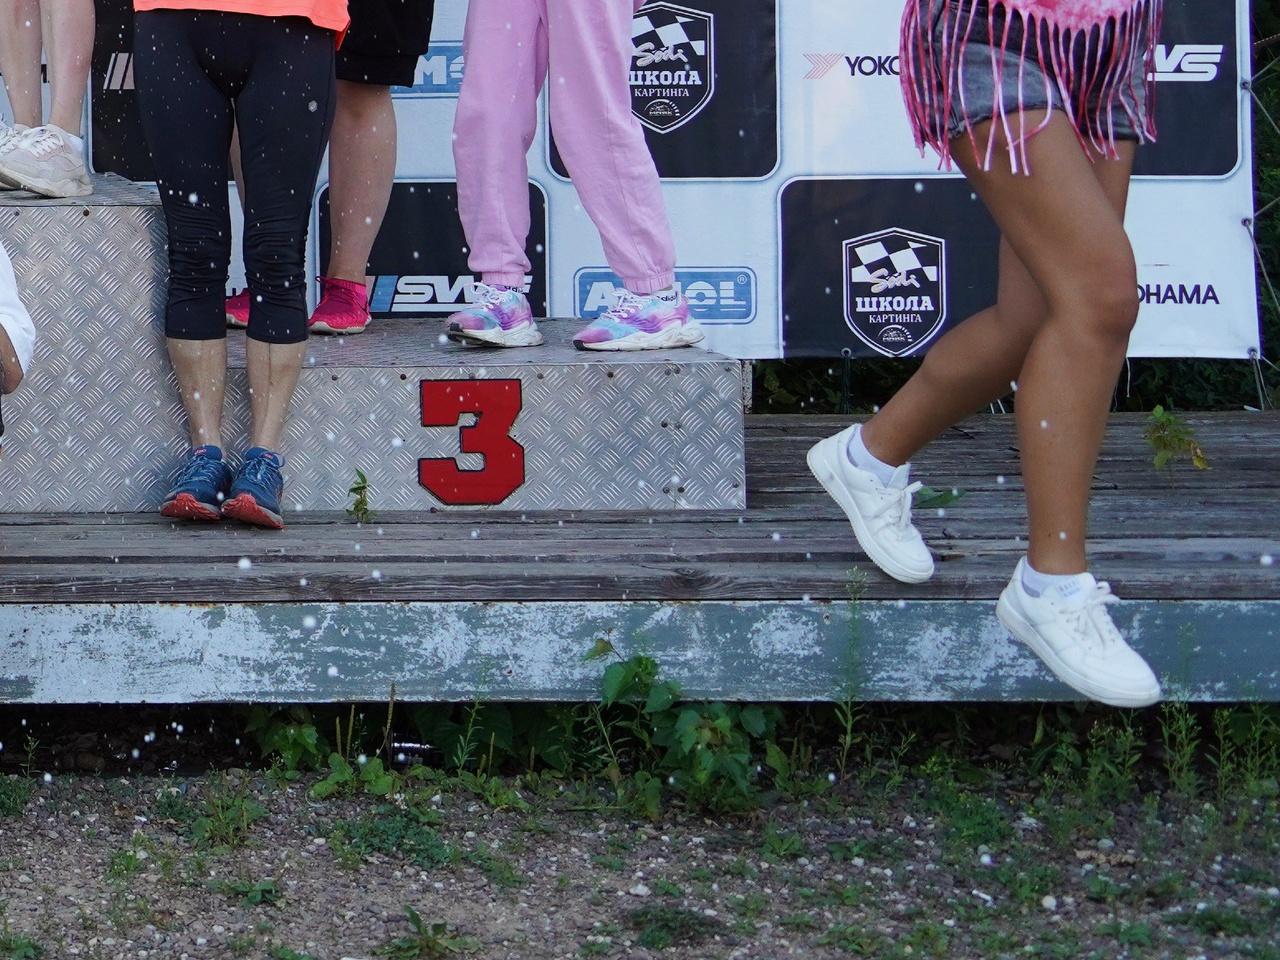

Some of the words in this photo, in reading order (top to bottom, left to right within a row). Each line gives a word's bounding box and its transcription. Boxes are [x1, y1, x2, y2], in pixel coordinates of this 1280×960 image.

[634, 88, 690, 97] КАРТИНГА
[856, 296, 934, 312] ШКОЛА
[869, 314, 922, 323] КАРТИНГА
[418, 379, 525, 506] 3
